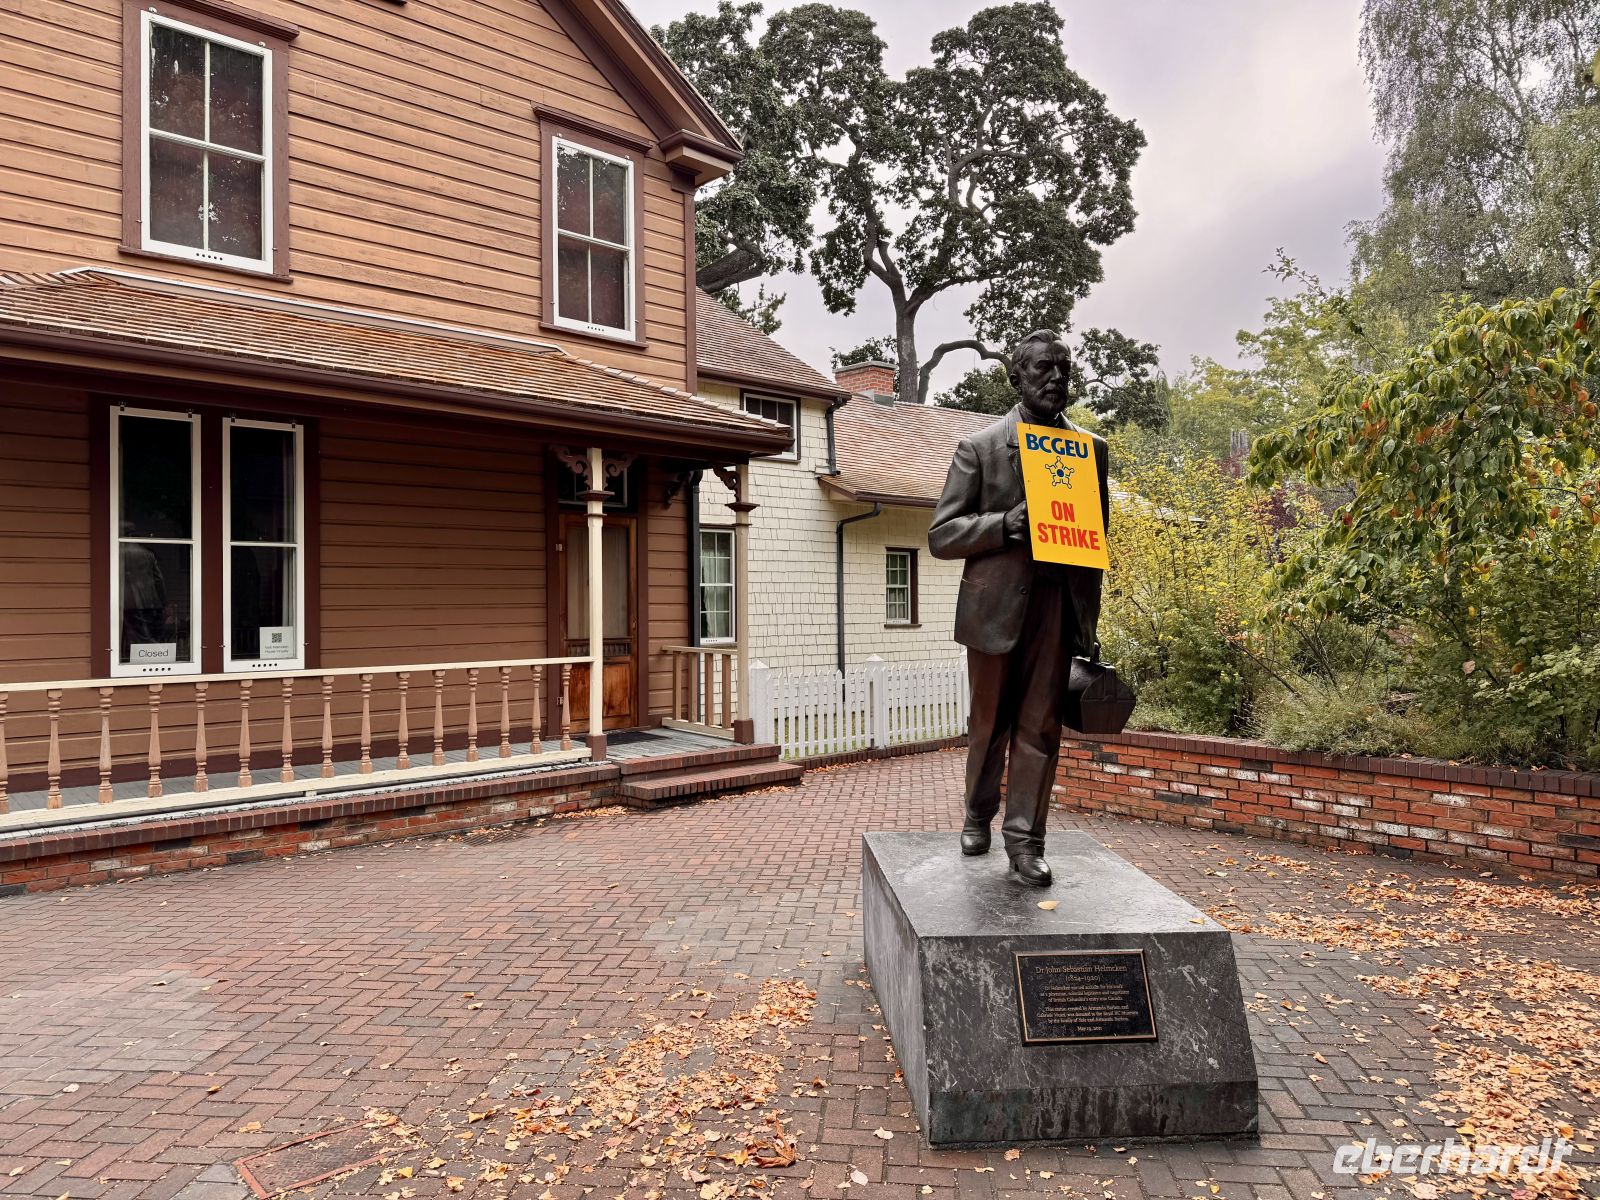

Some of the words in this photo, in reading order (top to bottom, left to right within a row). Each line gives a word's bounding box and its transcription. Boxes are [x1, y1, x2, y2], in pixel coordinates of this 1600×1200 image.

[1025, 433, 1089, 459] BCGEU
[1051, 500, 1076, 522] ON
[1037, 522, 1101, 551] STRIKE
[138, 649, 169, 658] Closed
[1045, 966, 1061, 974] John
[1062, 965, 1093, 973] Sebastian
[1094, 964, 1127, 972] Helmcken
